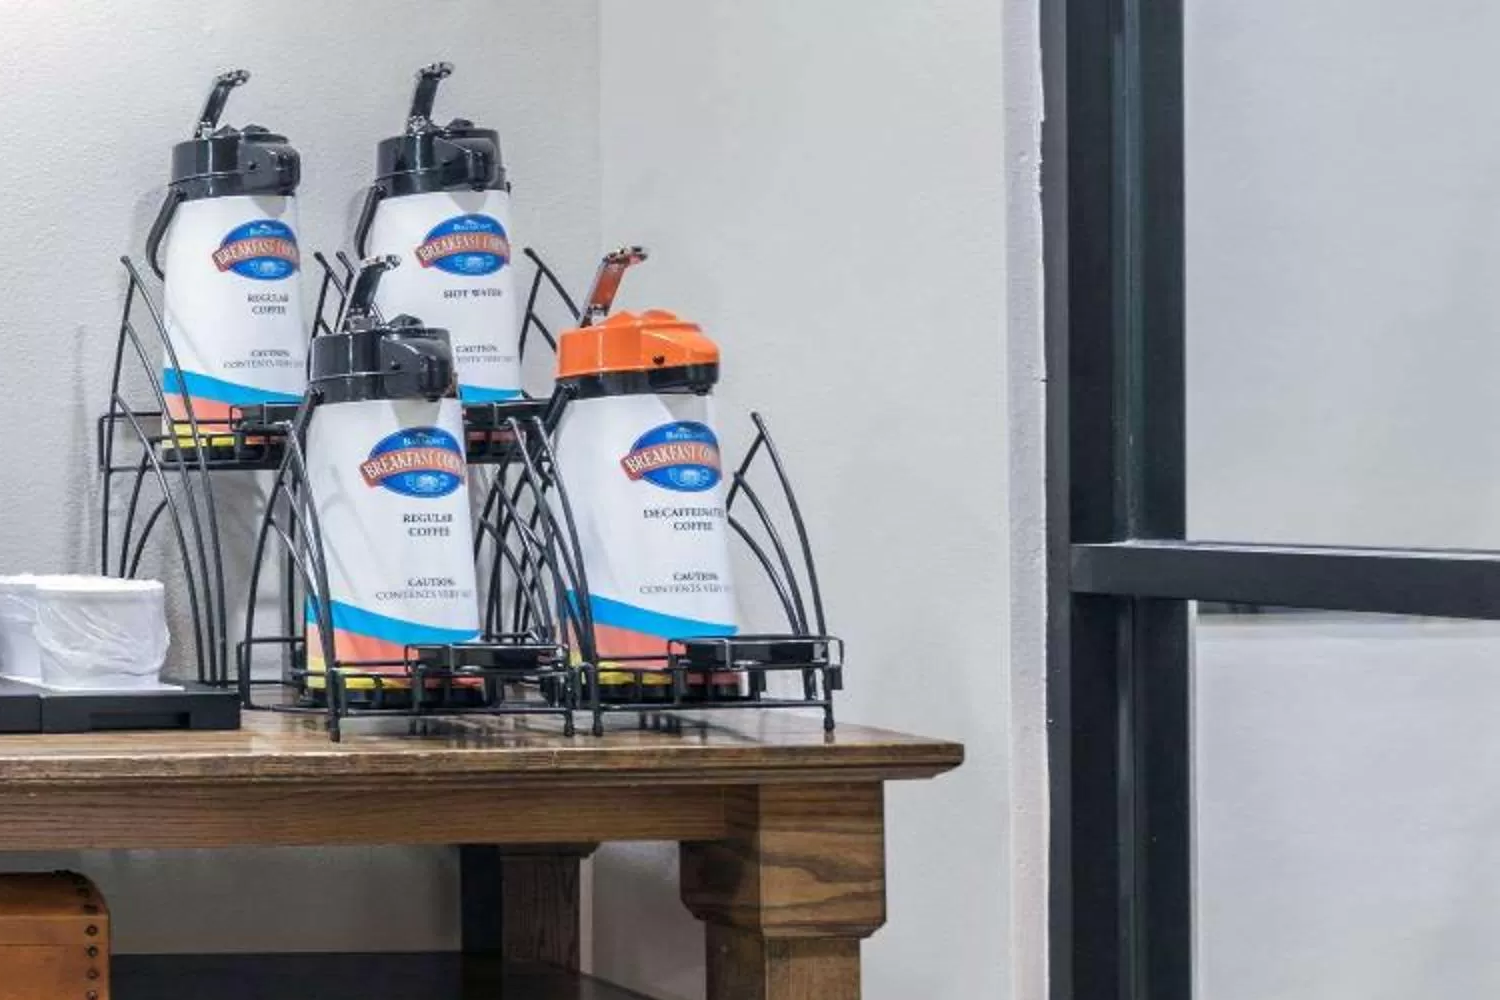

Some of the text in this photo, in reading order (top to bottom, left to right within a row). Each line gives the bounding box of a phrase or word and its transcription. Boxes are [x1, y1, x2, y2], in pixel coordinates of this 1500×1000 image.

[215, 238, 275, 266] BREAKFAST
[419, 232, 481, 262] BREAKFAST
[625, 442, 697, 474] BREAKFAST
[363, 448, 433, 480] BREAKFAST
[403, 513, 453, 523] REGULAR
[408, 526, 450, 537] COFFEE
[673, 521, 713, 531] COFFEE
[639, 583, 701, 594] CONTENTS
[376, 589, 437, 600] CONTENTS
